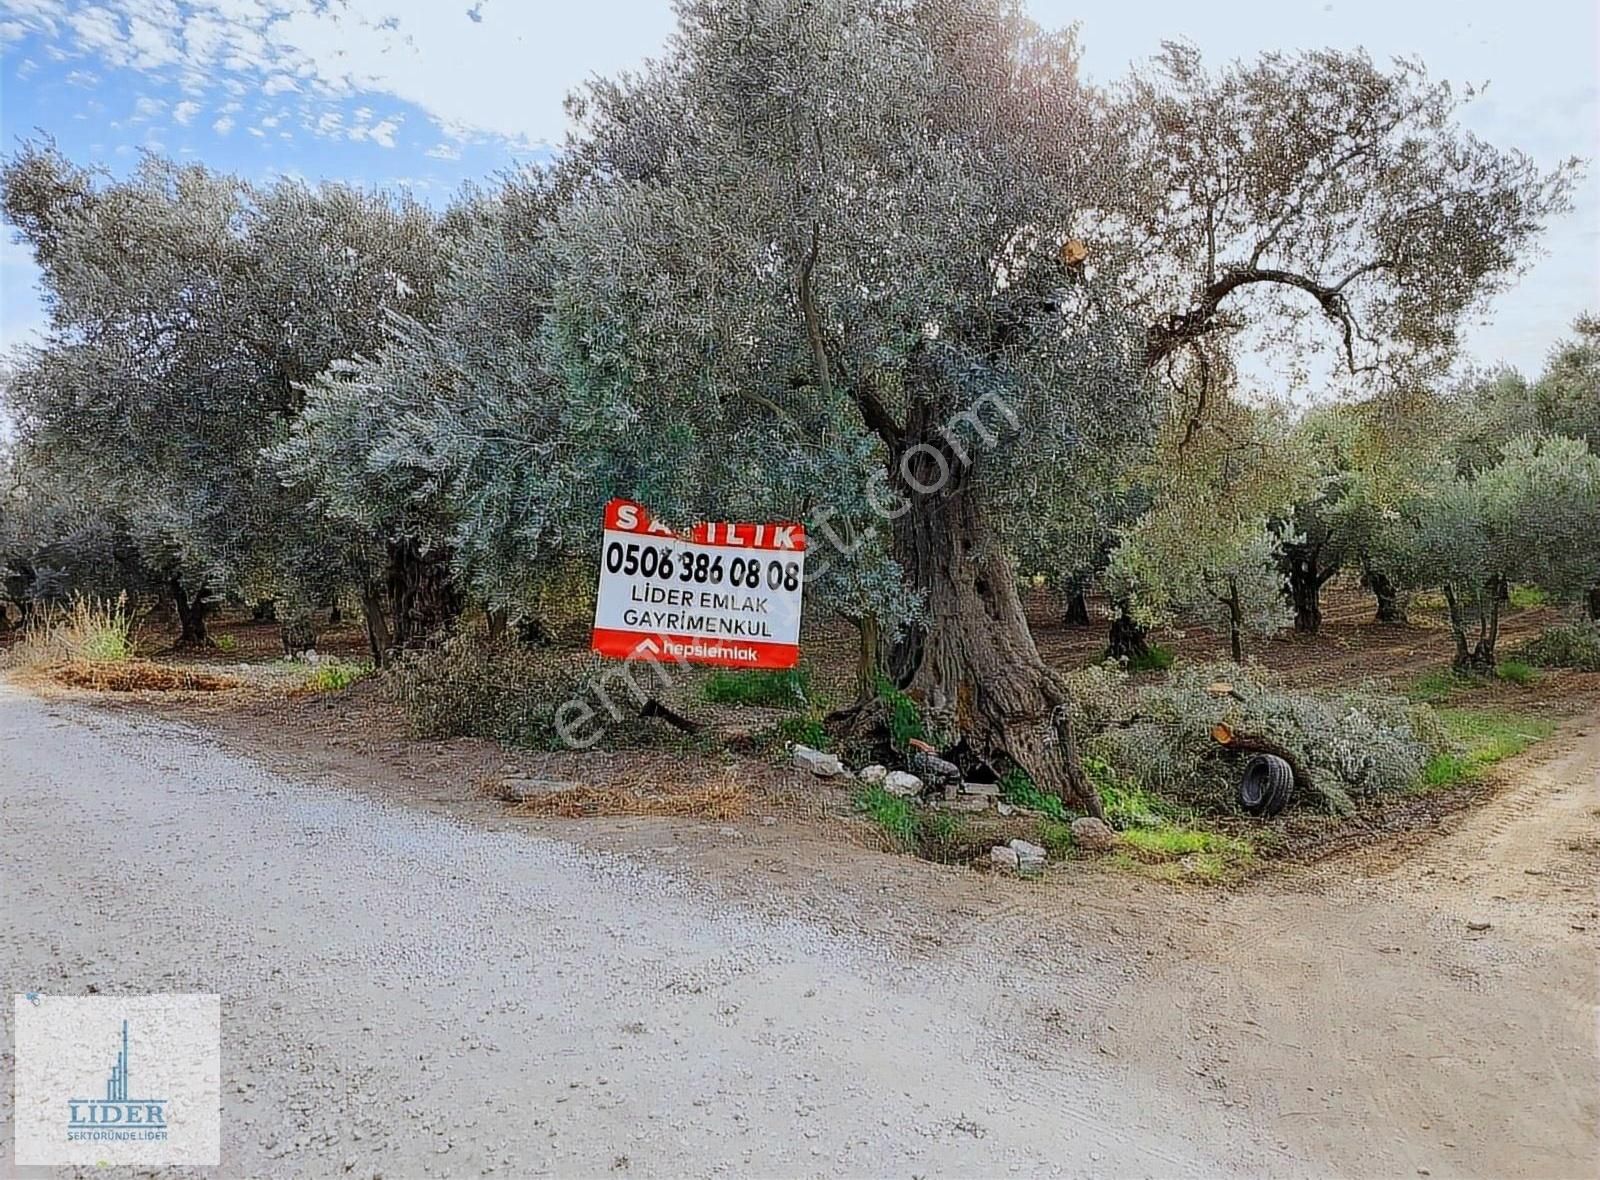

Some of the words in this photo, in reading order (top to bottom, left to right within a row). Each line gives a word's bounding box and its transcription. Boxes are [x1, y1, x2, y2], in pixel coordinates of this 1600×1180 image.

[615, 505, 797, 548] SAILIK
[606, 542, 674, 580] 0506
[679, 551, 724, 585] 386
[730, 557, 761, 589] 08
[767, 560, 799, 592] 08
[631, 582, 694, 606] LİDER
[700, 592, 769, 614] EMLAK
[623, 610, 772, 637] GAYRİMENKUL
[663, 639, 758, 661] hepsiemlak
